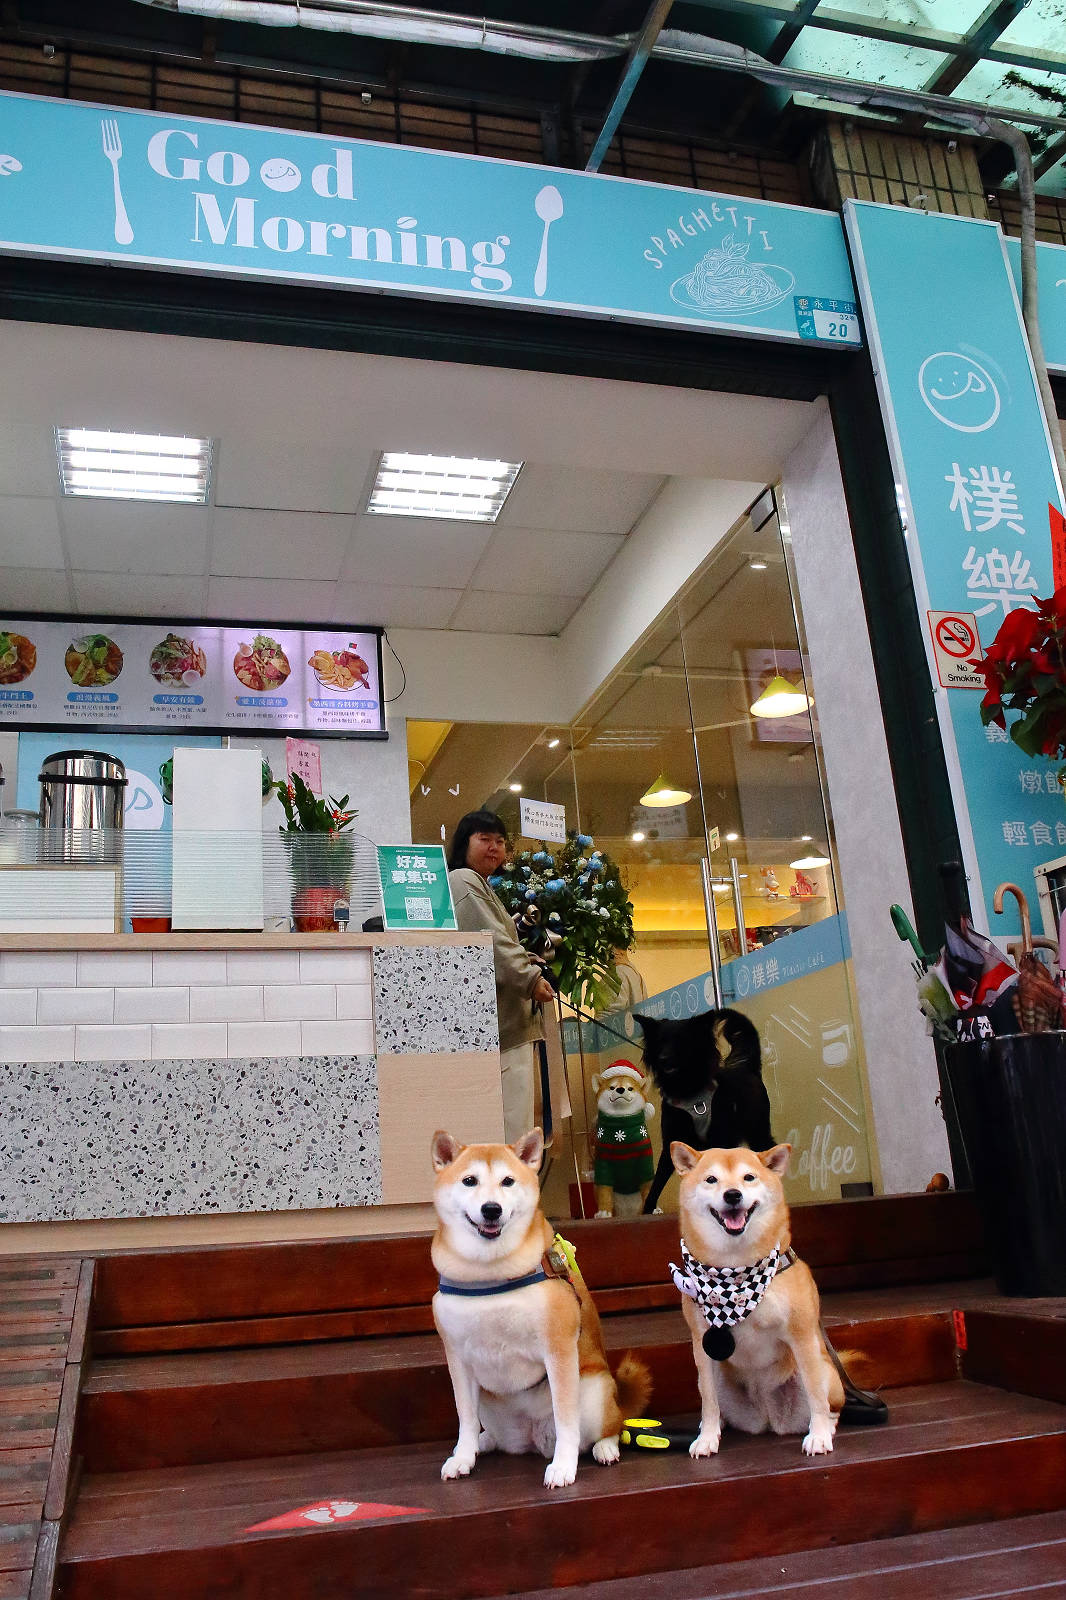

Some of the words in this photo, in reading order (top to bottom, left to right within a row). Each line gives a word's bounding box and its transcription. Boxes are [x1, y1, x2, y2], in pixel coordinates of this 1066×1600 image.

[190, 191, 513, 292] Morning
[643, 202, 775, 270] SPAGHETTI
[828, 322, 848, 338] 20
[944, 462, 1041, 618] 樸樂
[947, 674, 982, 684] Smoking
[956, 665, 968, 673] No
[396, 855, 428, 869] 好友
[391, 870, 438, 885] 募集中
[752, 957, 779, 989] 樸樂
[785, 1124, 857, 1191] Coffee
